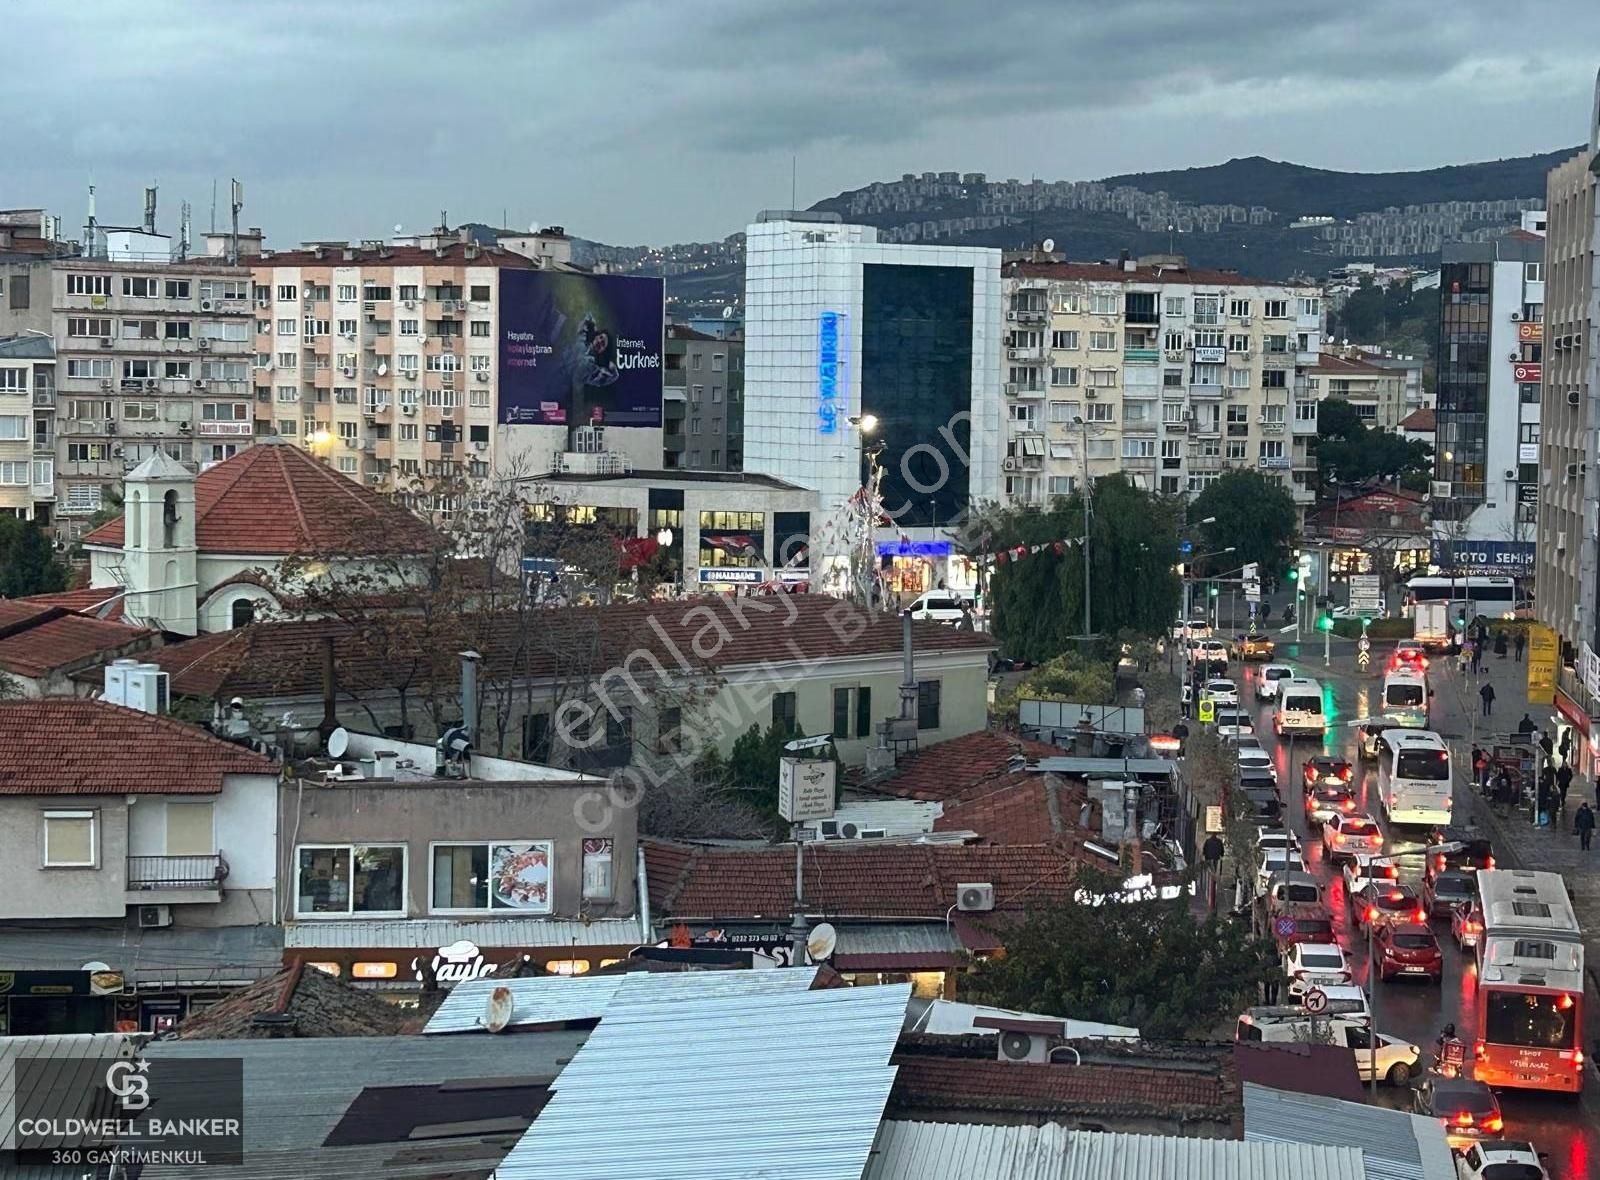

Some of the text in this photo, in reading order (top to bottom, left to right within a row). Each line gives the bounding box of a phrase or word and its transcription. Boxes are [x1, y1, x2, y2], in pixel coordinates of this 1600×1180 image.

[616, 349, 660, 369] turknet
[1453, 552, 1488, 563] FOTO
[715, 571, 756, 580] HALKBANK
